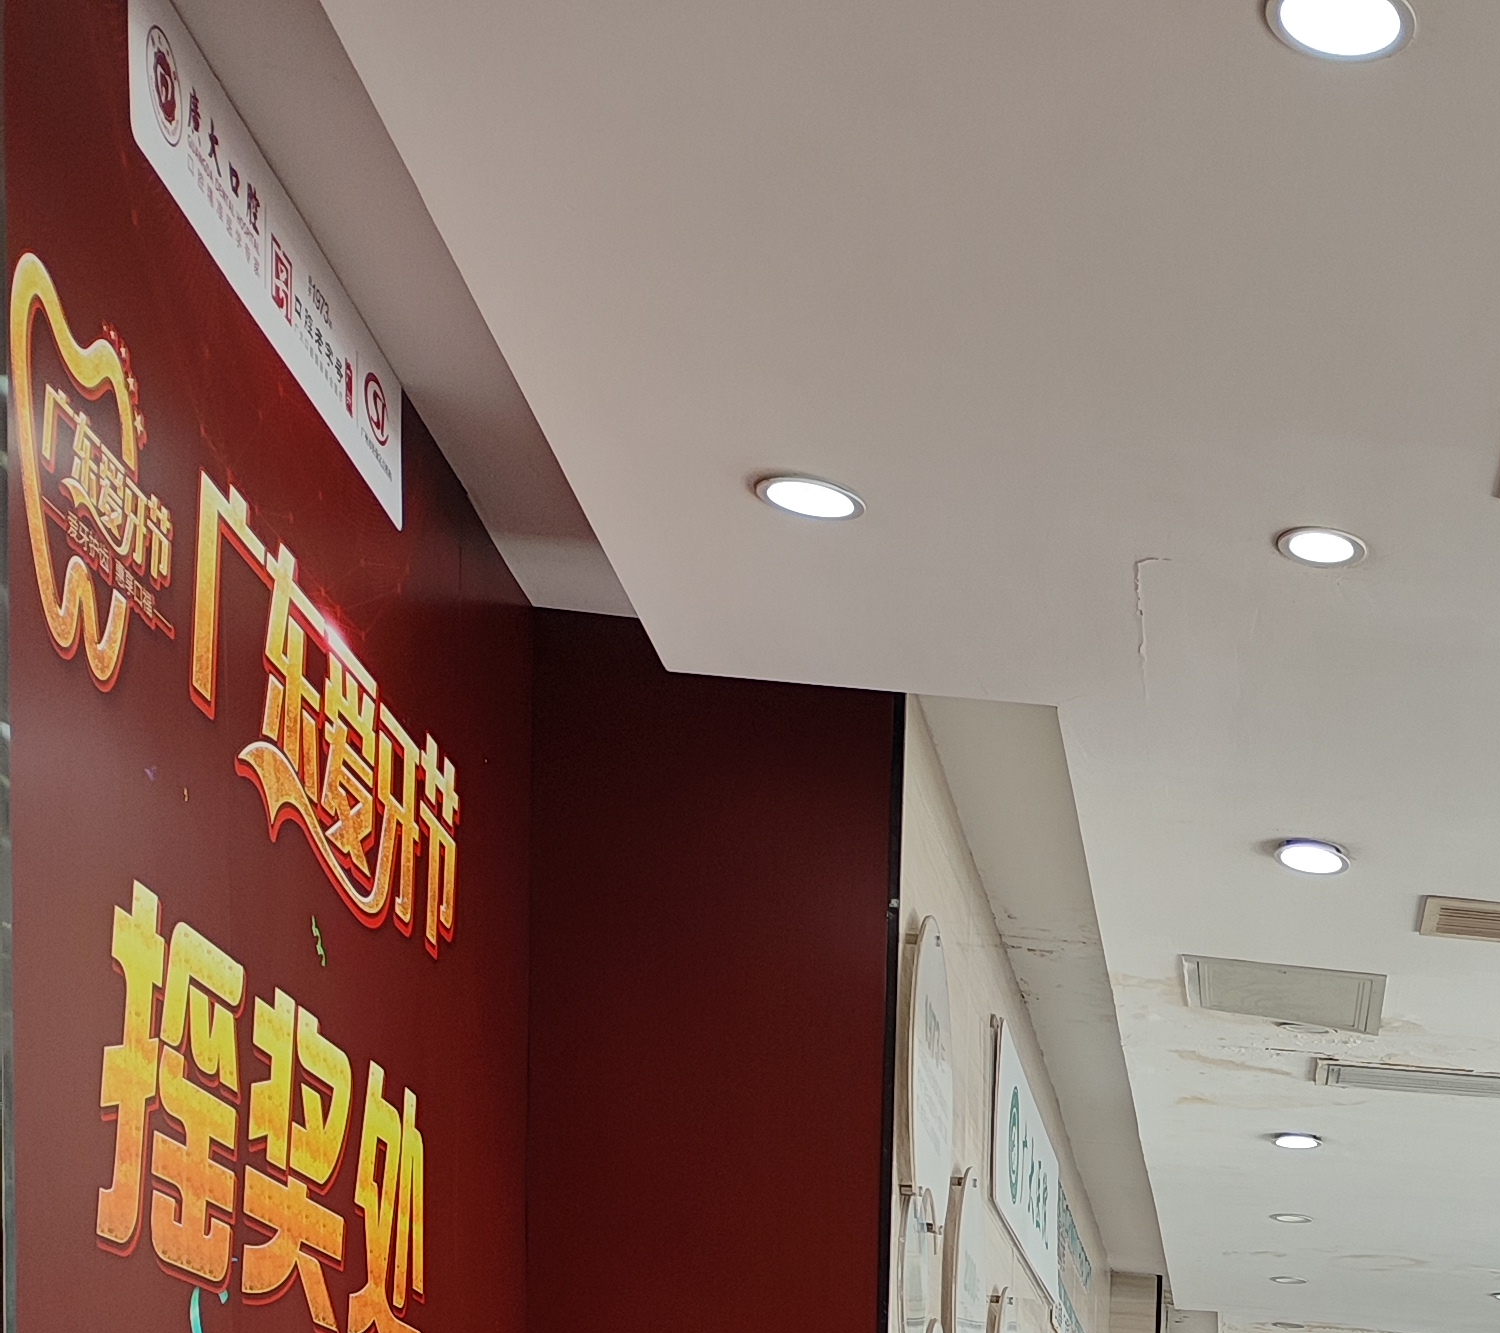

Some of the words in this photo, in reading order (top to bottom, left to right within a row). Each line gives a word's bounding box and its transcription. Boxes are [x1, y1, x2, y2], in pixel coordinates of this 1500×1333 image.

[42, 383, 172, 581] 广东爱牙节
[67, 510, 110, 574] 爱牙护齿
[191, 468, 459, 952] 广东爱牙节
